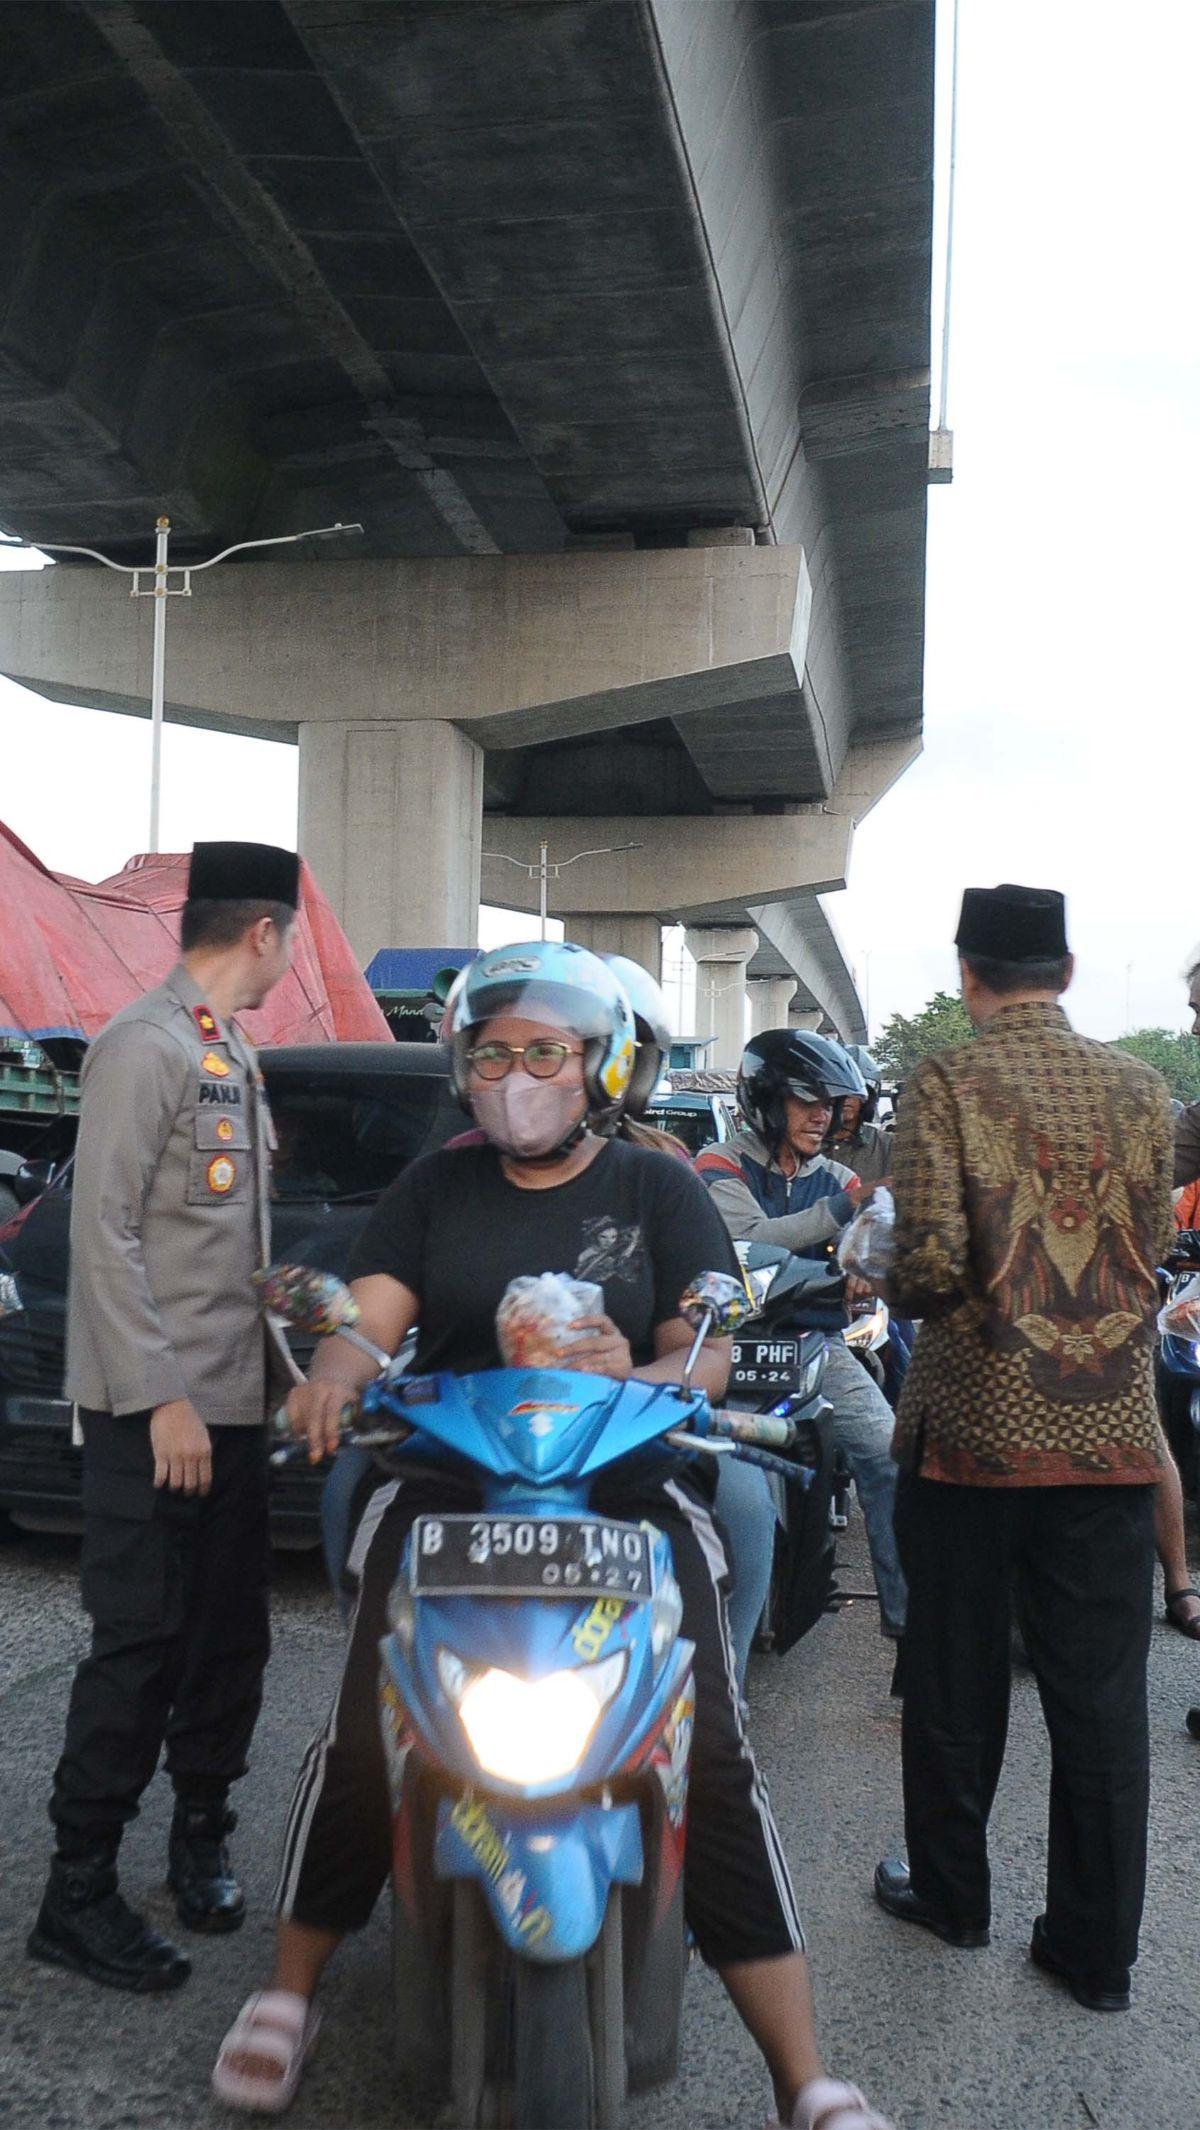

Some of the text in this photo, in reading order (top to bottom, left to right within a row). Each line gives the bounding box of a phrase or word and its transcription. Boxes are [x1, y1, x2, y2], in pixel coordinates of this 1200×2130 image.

[666, 1109, 697, 1118] Group
[756, 1345, 793, 1363] PHF
[422, 1521, 444, 1556] B
[468, 1522, 559, 1564] 3509
